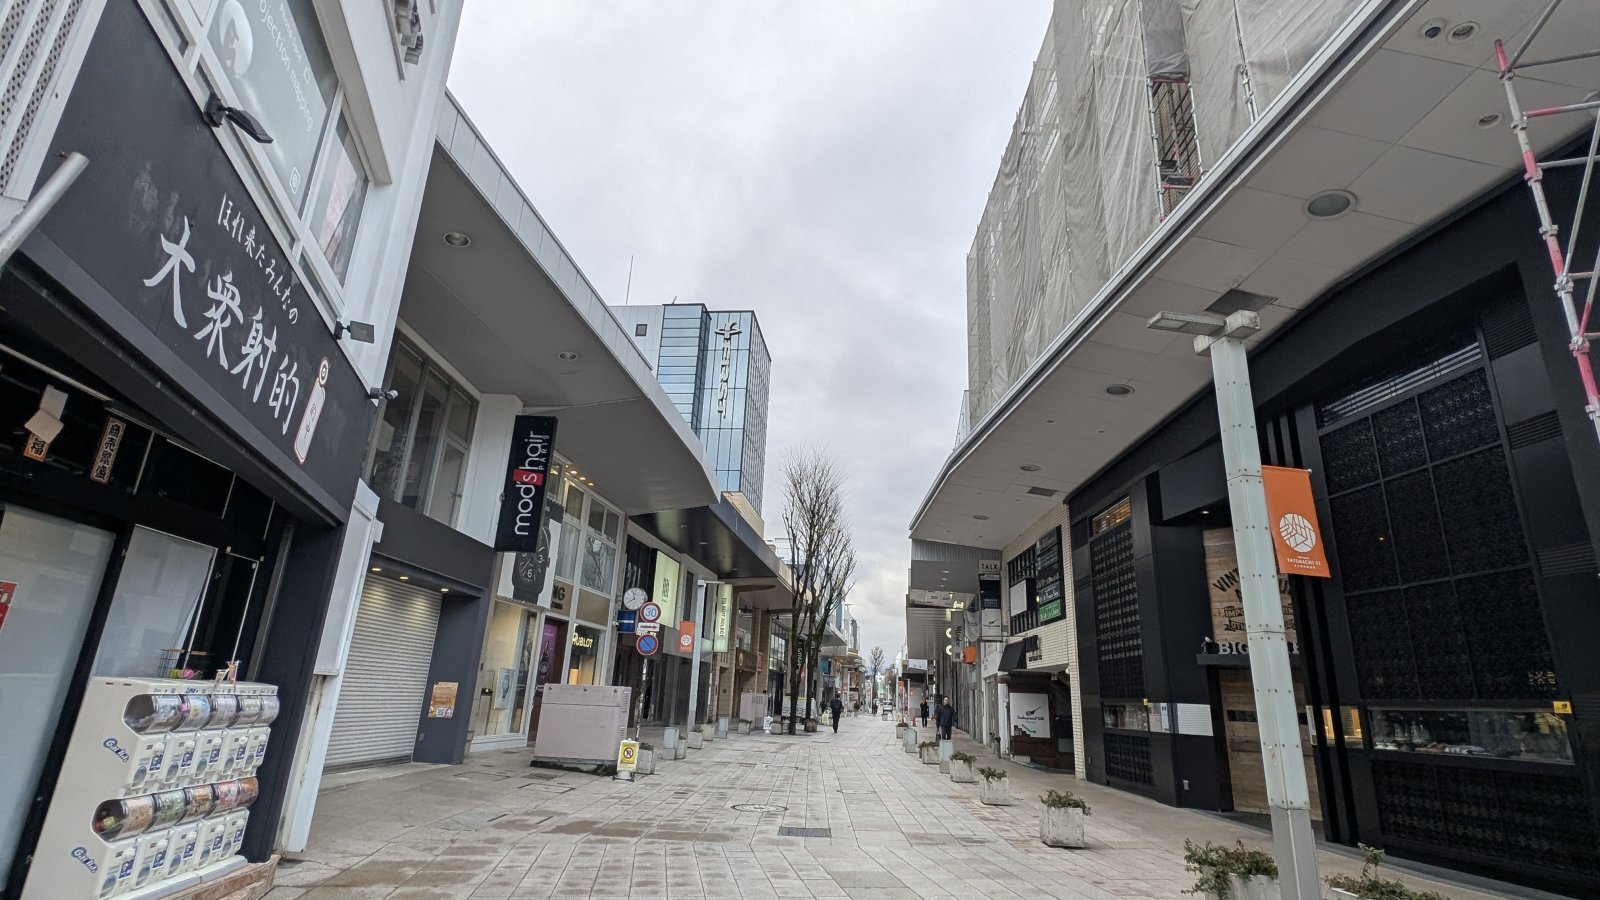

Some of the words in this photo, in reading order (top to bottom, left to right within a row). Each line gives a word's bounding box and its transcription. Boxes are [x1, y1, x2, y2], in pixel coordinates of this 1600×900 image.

[290, 70, 313, 132] mapping
[217, 192, 299, 325] ほれ来たみんなの
[143, 215, 300, 436] 大衆射的
[519, 430, 543, 470] hair
[538, 434, 550, 471] PARIS
[981, 562, 998, 570] TALK
[645, 607, 657, 617] 30
